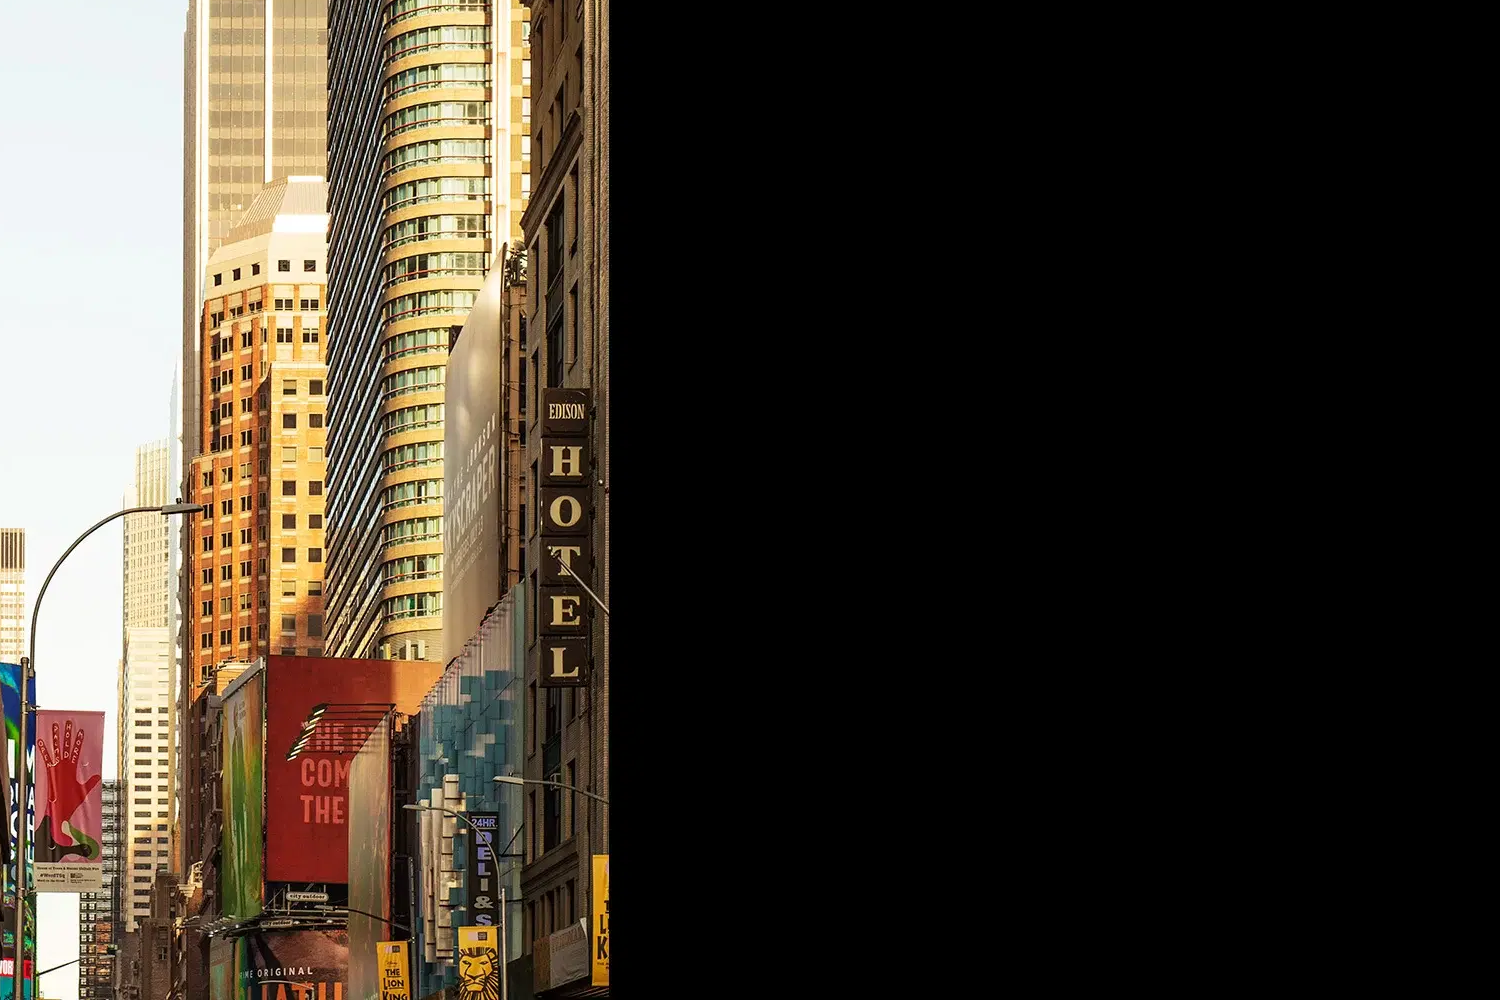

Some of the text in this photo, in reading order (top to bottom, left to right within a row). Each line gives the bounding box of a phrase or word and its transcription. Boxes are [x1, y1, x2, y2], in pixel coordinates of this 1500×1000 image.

[549, 404, 585, 419] EDISON
[550, 445, 582, 678] HOTEL
[63, 724, 71, 759] HOLD
[71, 731, 83, 764] MORE
[301, 795, 344, 824] THE
[475, 831, 492, 892] DELI
[474, 895, 494, 909] &
[257, 966, 313, 978] ORIGINAL
[385, 968, 400, 976] THE
[383, 977, 404, 990] LION
